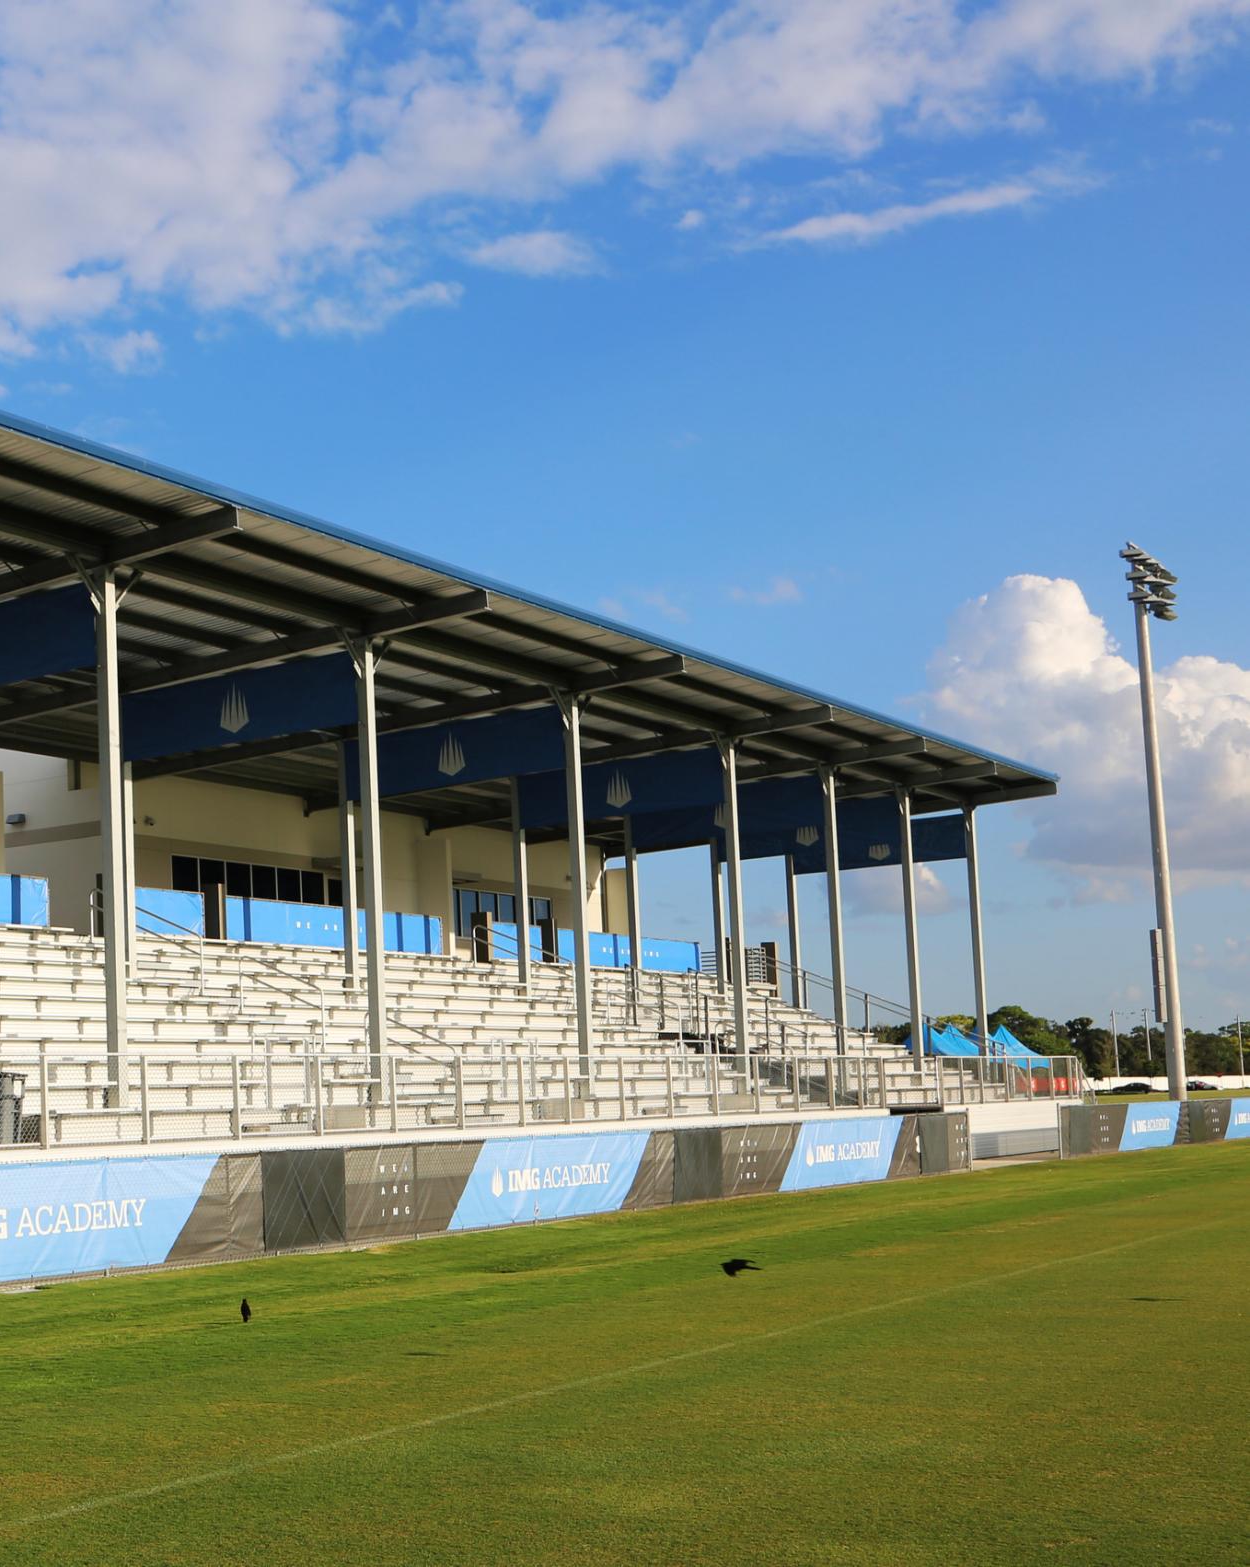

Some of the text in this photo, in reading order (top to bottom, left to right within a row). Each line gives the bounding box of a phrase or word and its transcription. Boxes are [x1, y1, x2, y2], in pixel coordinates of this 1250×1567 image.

[815, 1141, 880, 1163] IMG ACADEMY
[508, 1162, 610, 1192] IMG ACADEMY
[381, 1184, 410, 1195] ARE
[15, 1198, 146, 1237] ACADEMY
[382, 1206, 410, 1217] IMG
